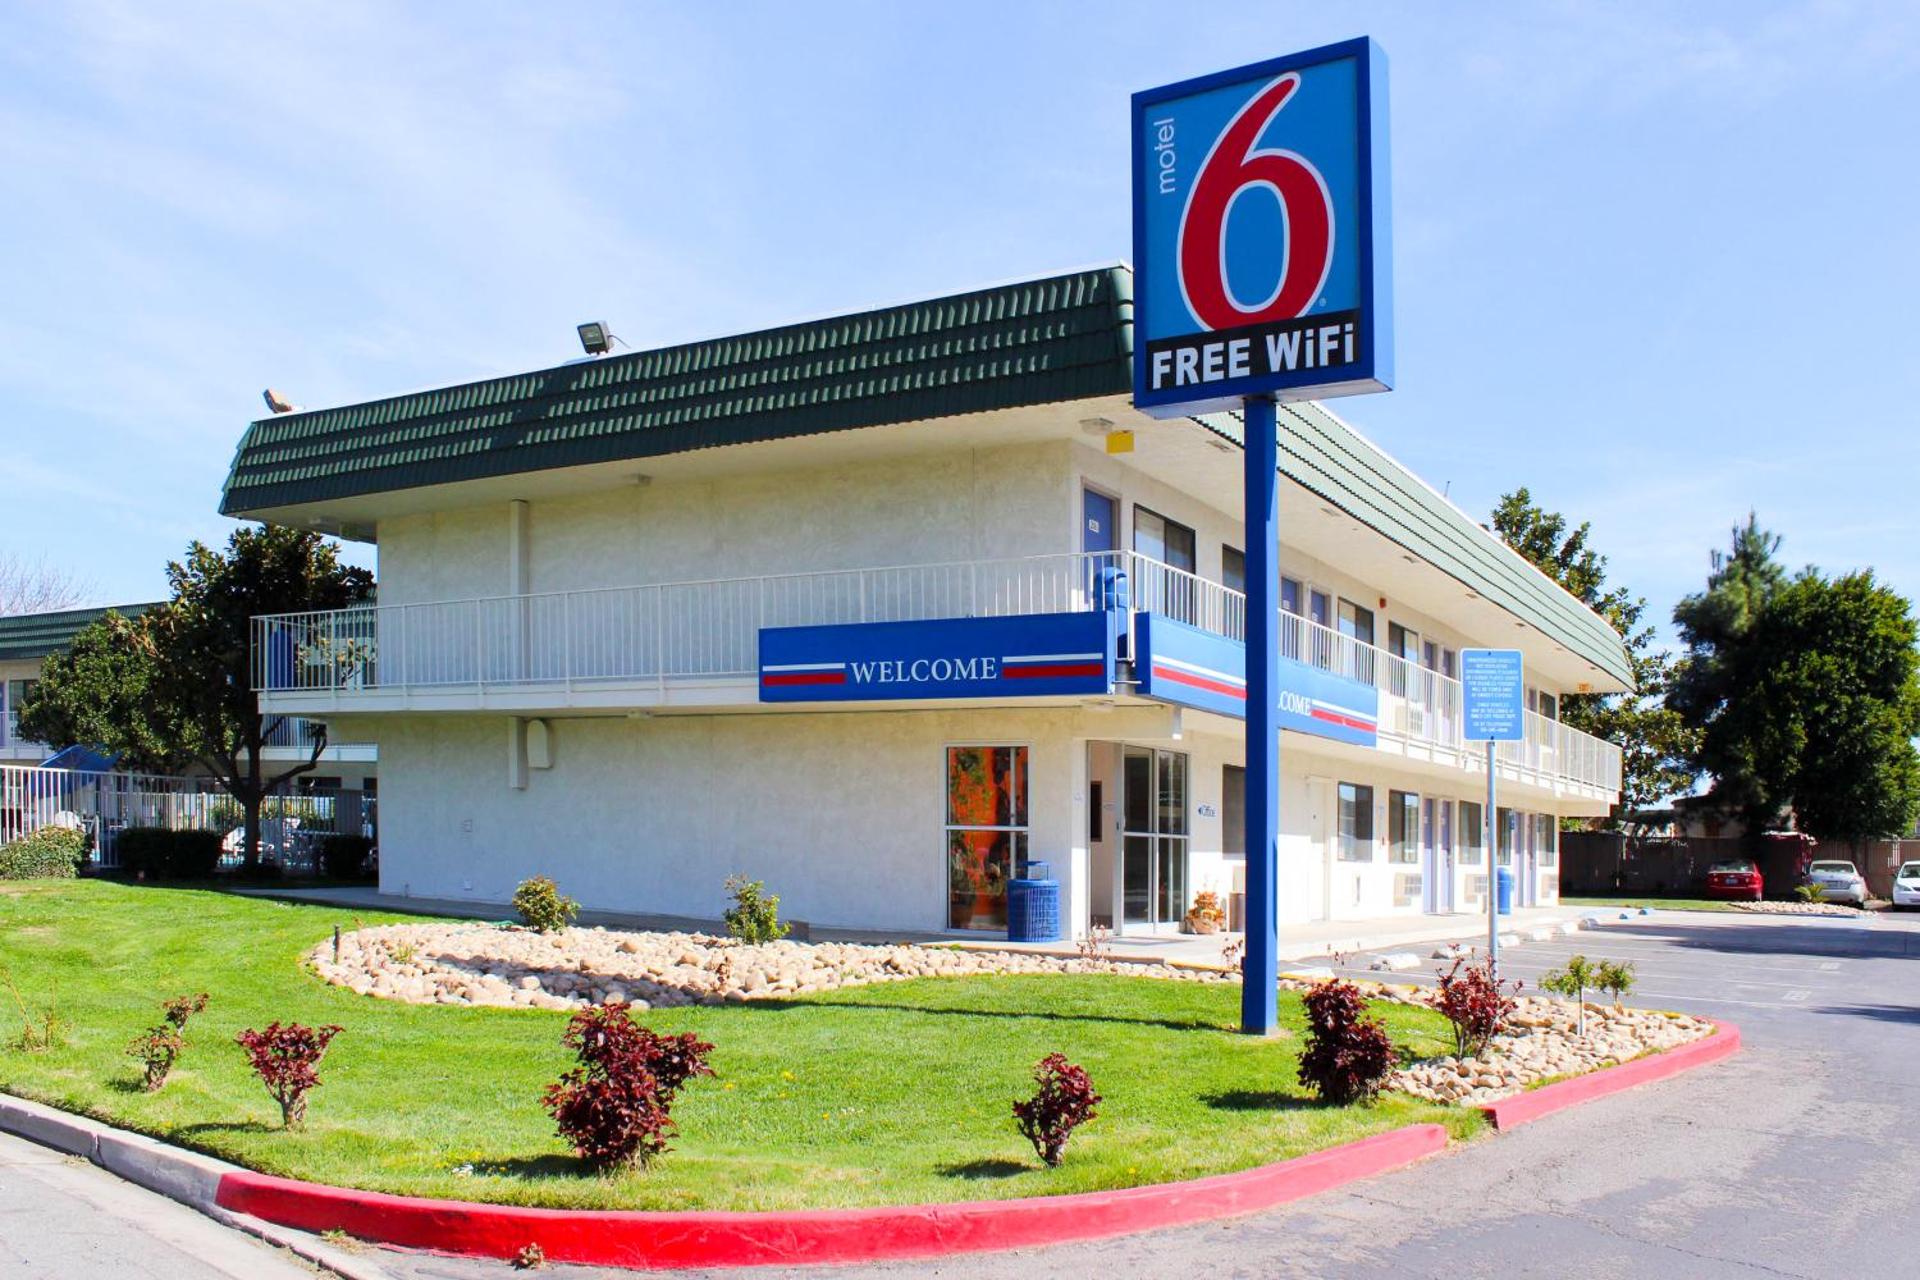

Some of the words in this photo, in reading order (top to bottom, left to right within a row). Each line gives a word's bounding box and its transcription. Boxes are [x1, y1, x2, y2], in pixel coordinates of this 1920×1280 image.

[1154, 117, 1175, 194] motel
[1177, 71, 1335, 332] 6
[1152, 338, 1250, 390] FREE
[1266, 323, 1355, 372] WiFi
[851, 657, 997, 684] WELCOME
